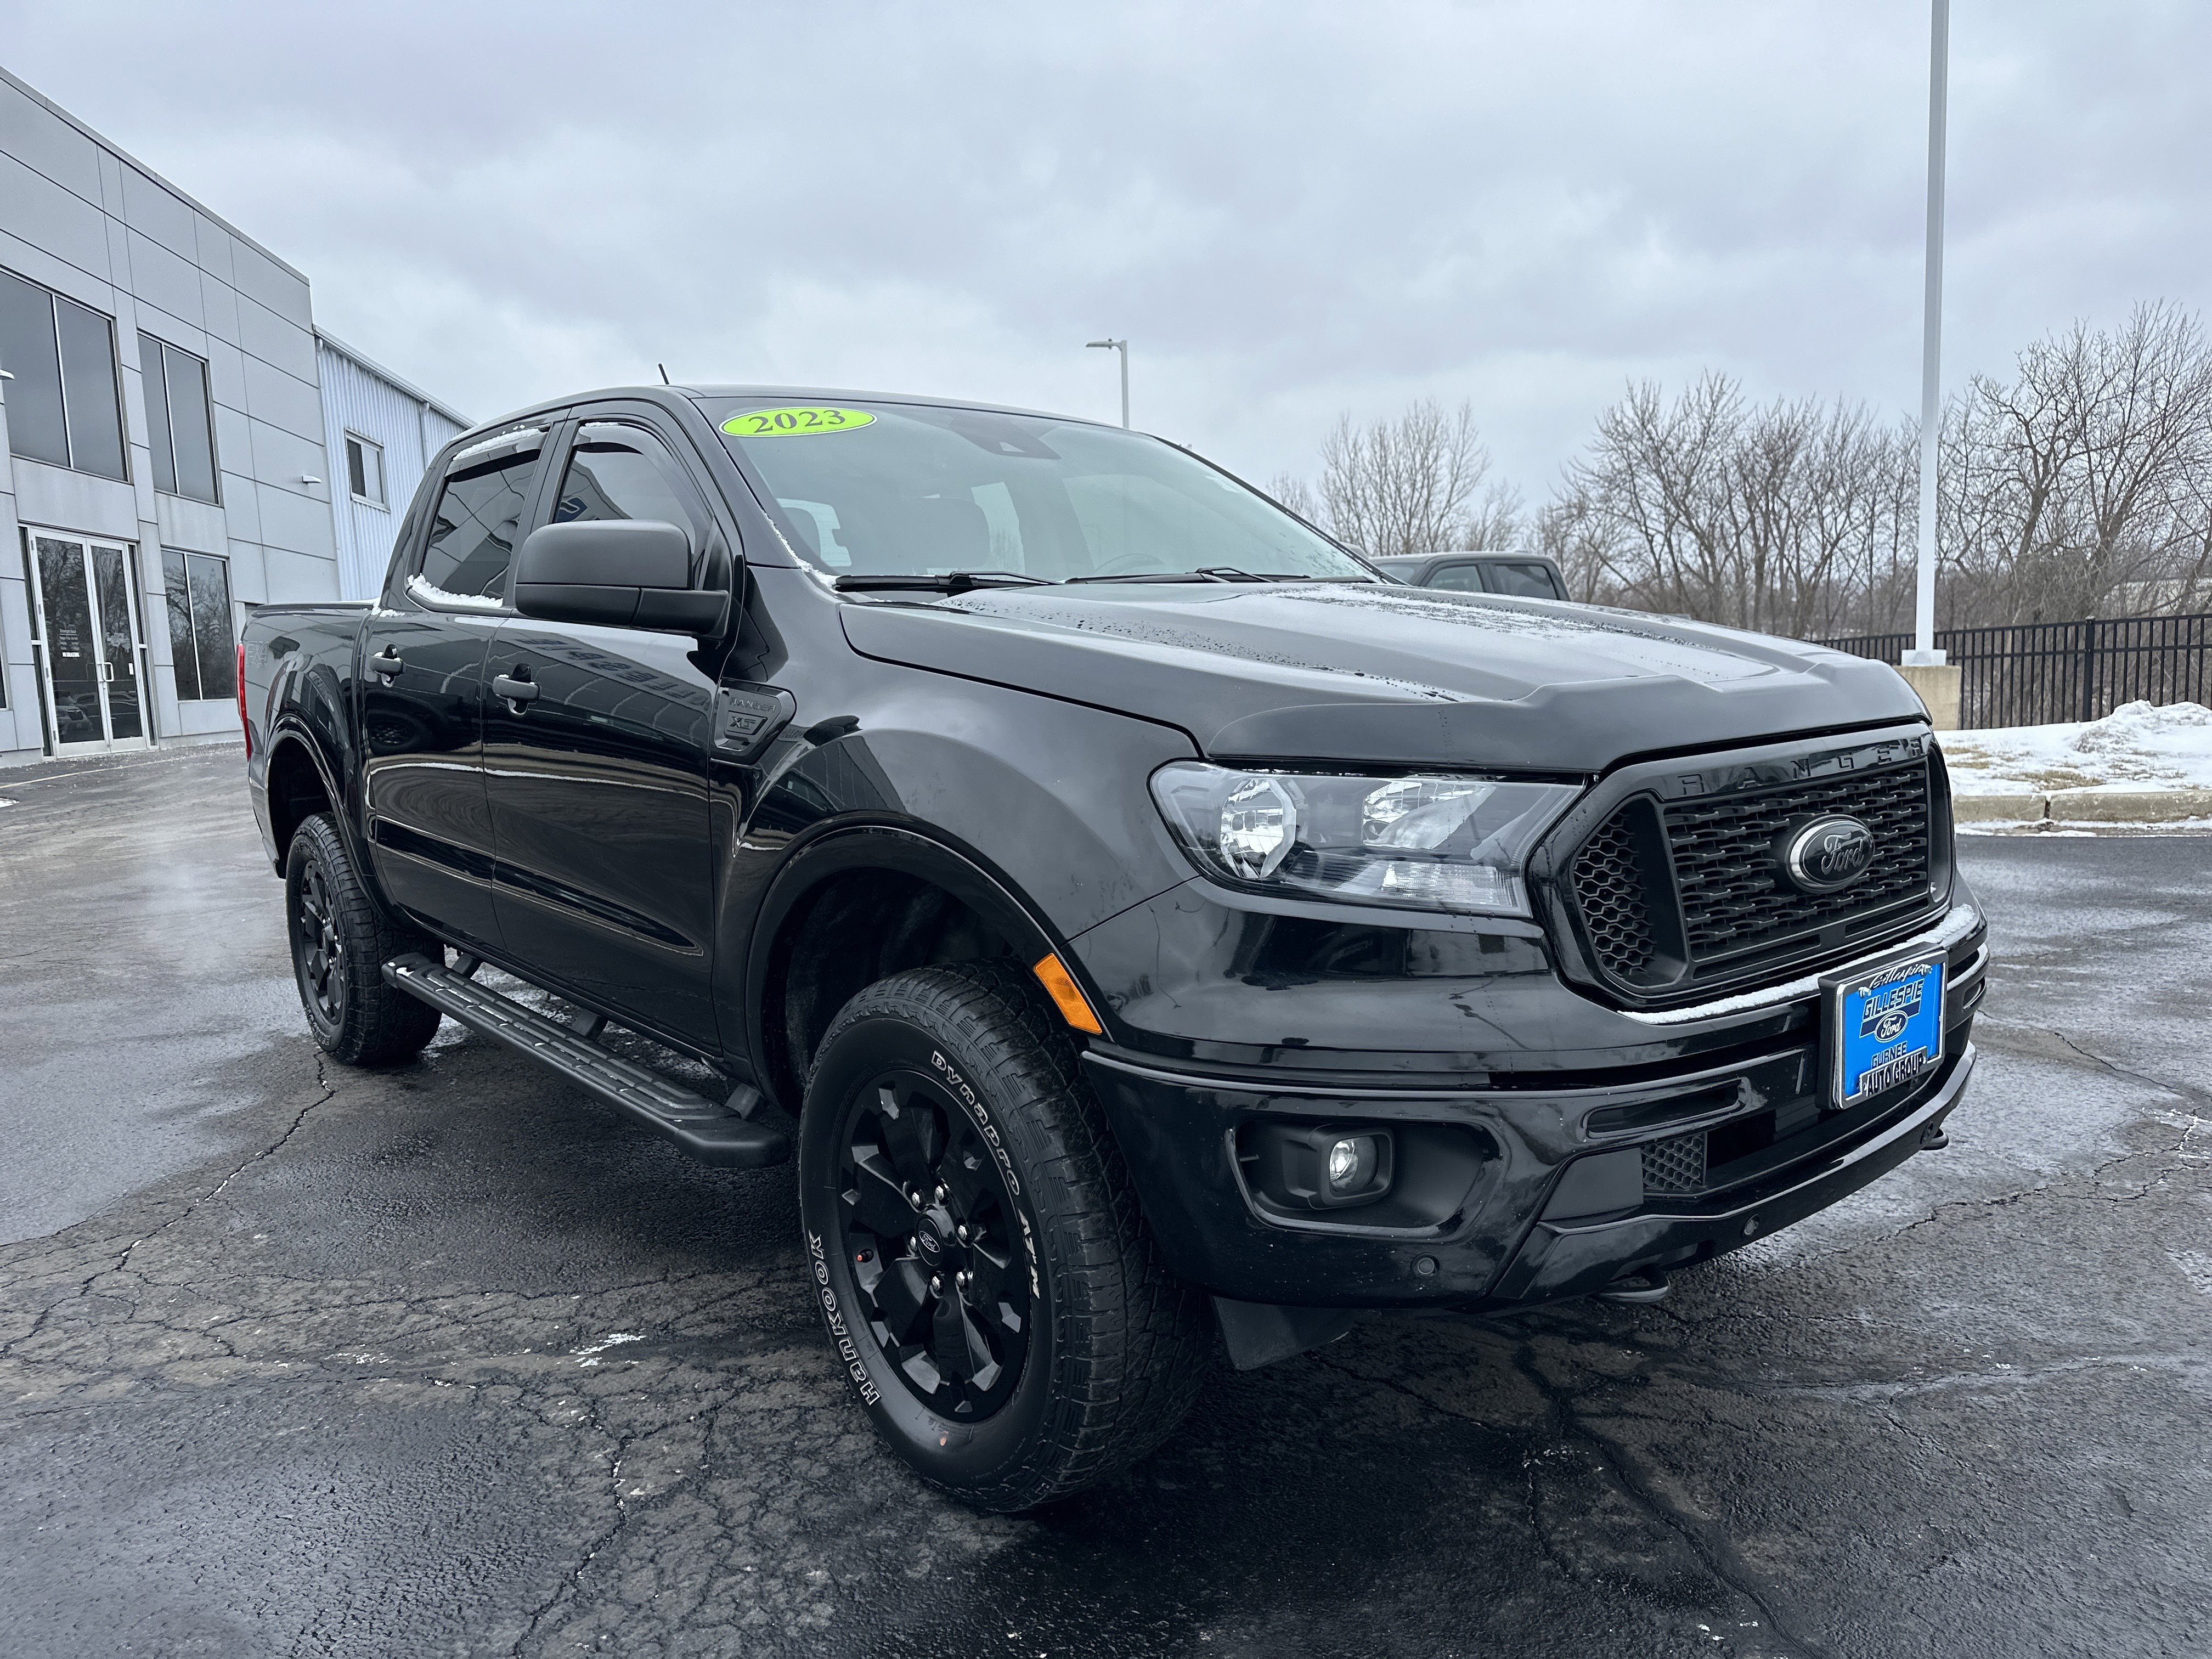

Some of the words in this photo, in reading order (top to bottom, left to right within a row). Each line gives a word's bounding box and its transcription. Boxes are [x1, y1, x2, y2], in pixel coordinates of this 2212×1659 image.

[748, 410, 845, 433] 2023
[245, 641, 269, 668] FX4
[730, 697, 776, 712] RANGER
[730, 716, 756, 730] XLT
[1678, 737, 1921, 795] RANGER
[1821, 830, 1864, 874] Ford
[1863, 979, 1925, 1020] GILLESPIE
[1881, 1017, 1902, 1037] Ford
[1871, 1041, 1908, 1069] GURNEE
[1866, 1066, 1891, 1097] AUTO
[1892, 1052, 1925, 1084] GROUP
